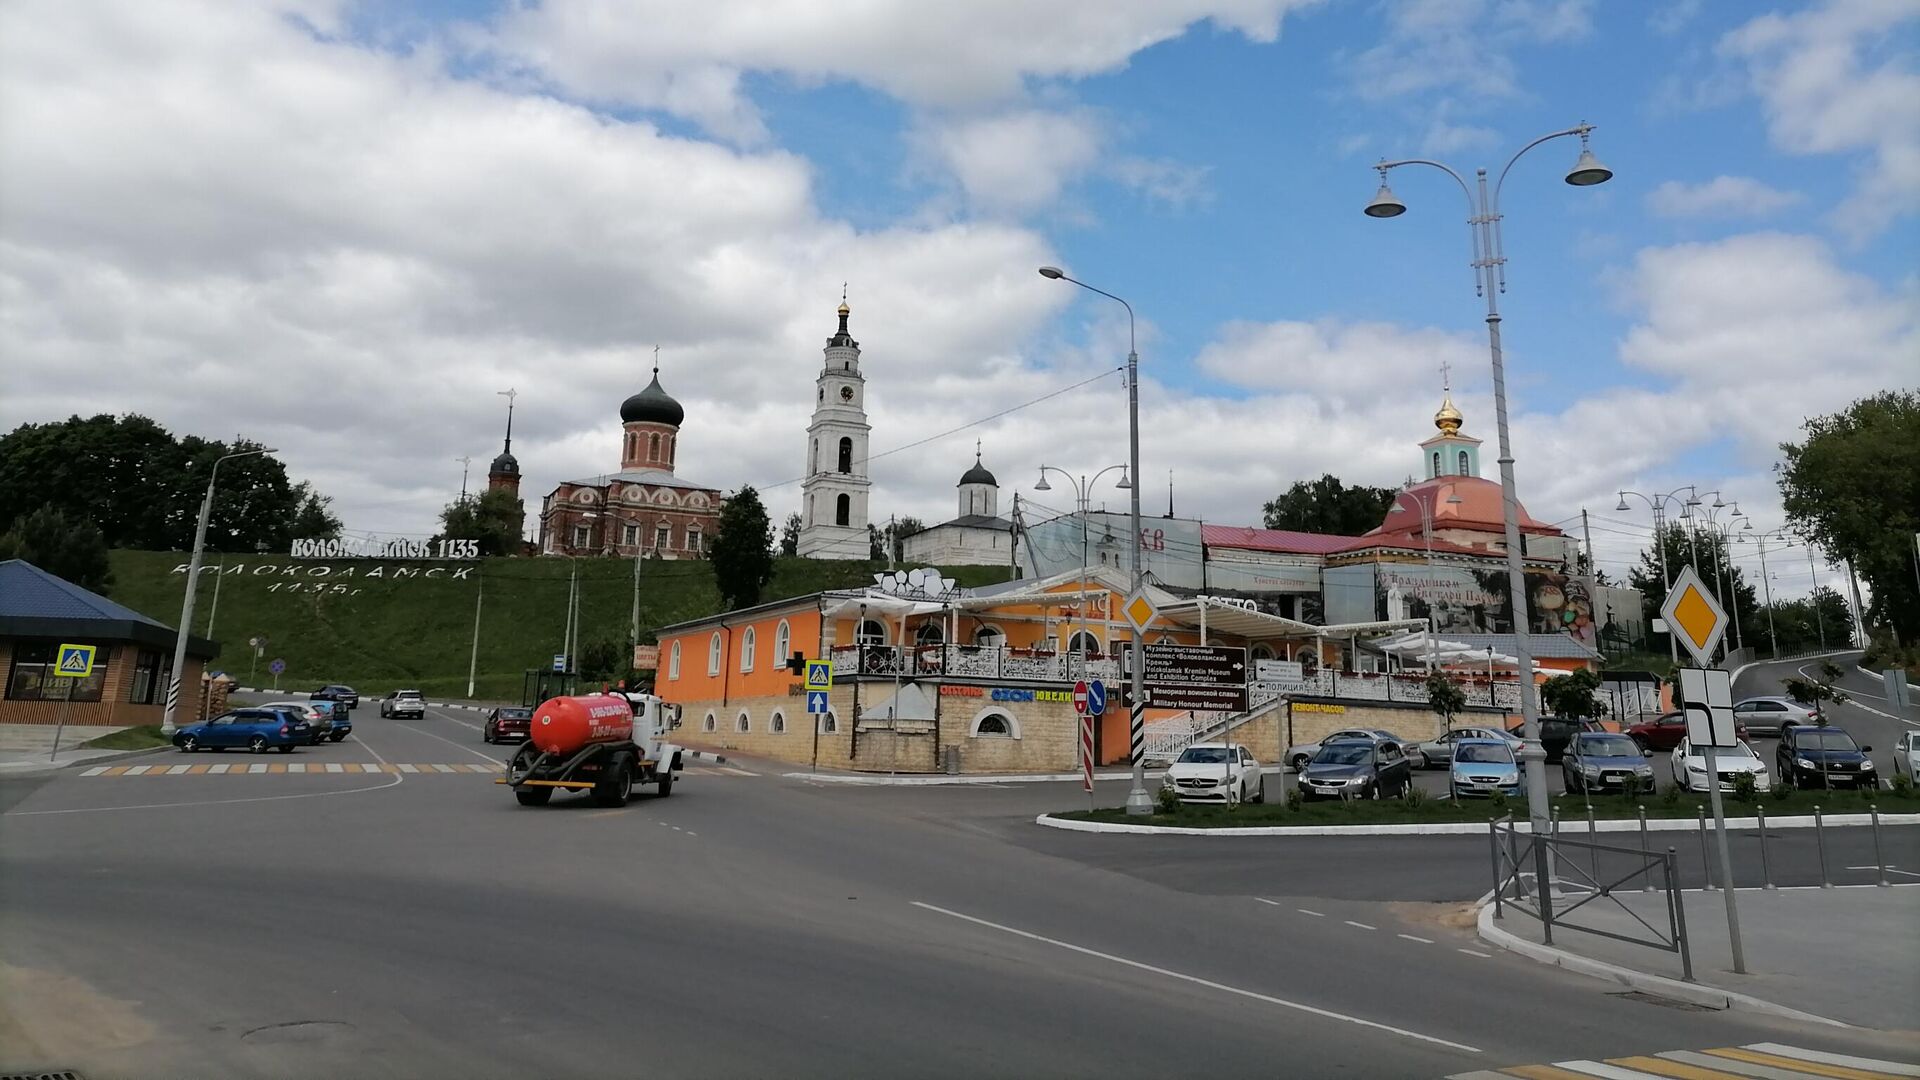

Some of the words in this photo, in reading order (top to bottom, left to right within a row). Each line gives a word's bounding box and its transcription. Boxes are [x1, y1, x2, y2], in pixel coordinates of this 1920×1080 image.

[438, 538, 479, 558] 1135
[1146, 666, 1182, 674] Volokolamsk
[1184, 667, 1206, 675] Kremlin
[1190, 674, 1217, 682] Complex
[940, 685, 984, 697] ОПТИКА
[1266, 683, 1304, 692] ПОЛИЦИЯ
[1035, 690, 1073, 703] ЮВЕЛИ
[1153, 688, 1186, 696] Мемориал
[1187, 688, 1217, 697] воинской
[1218, 690, 1240, 698] славы
[1153, 700, 1177, 708] Military
[1203, 701, 1233, 709] Memorial
